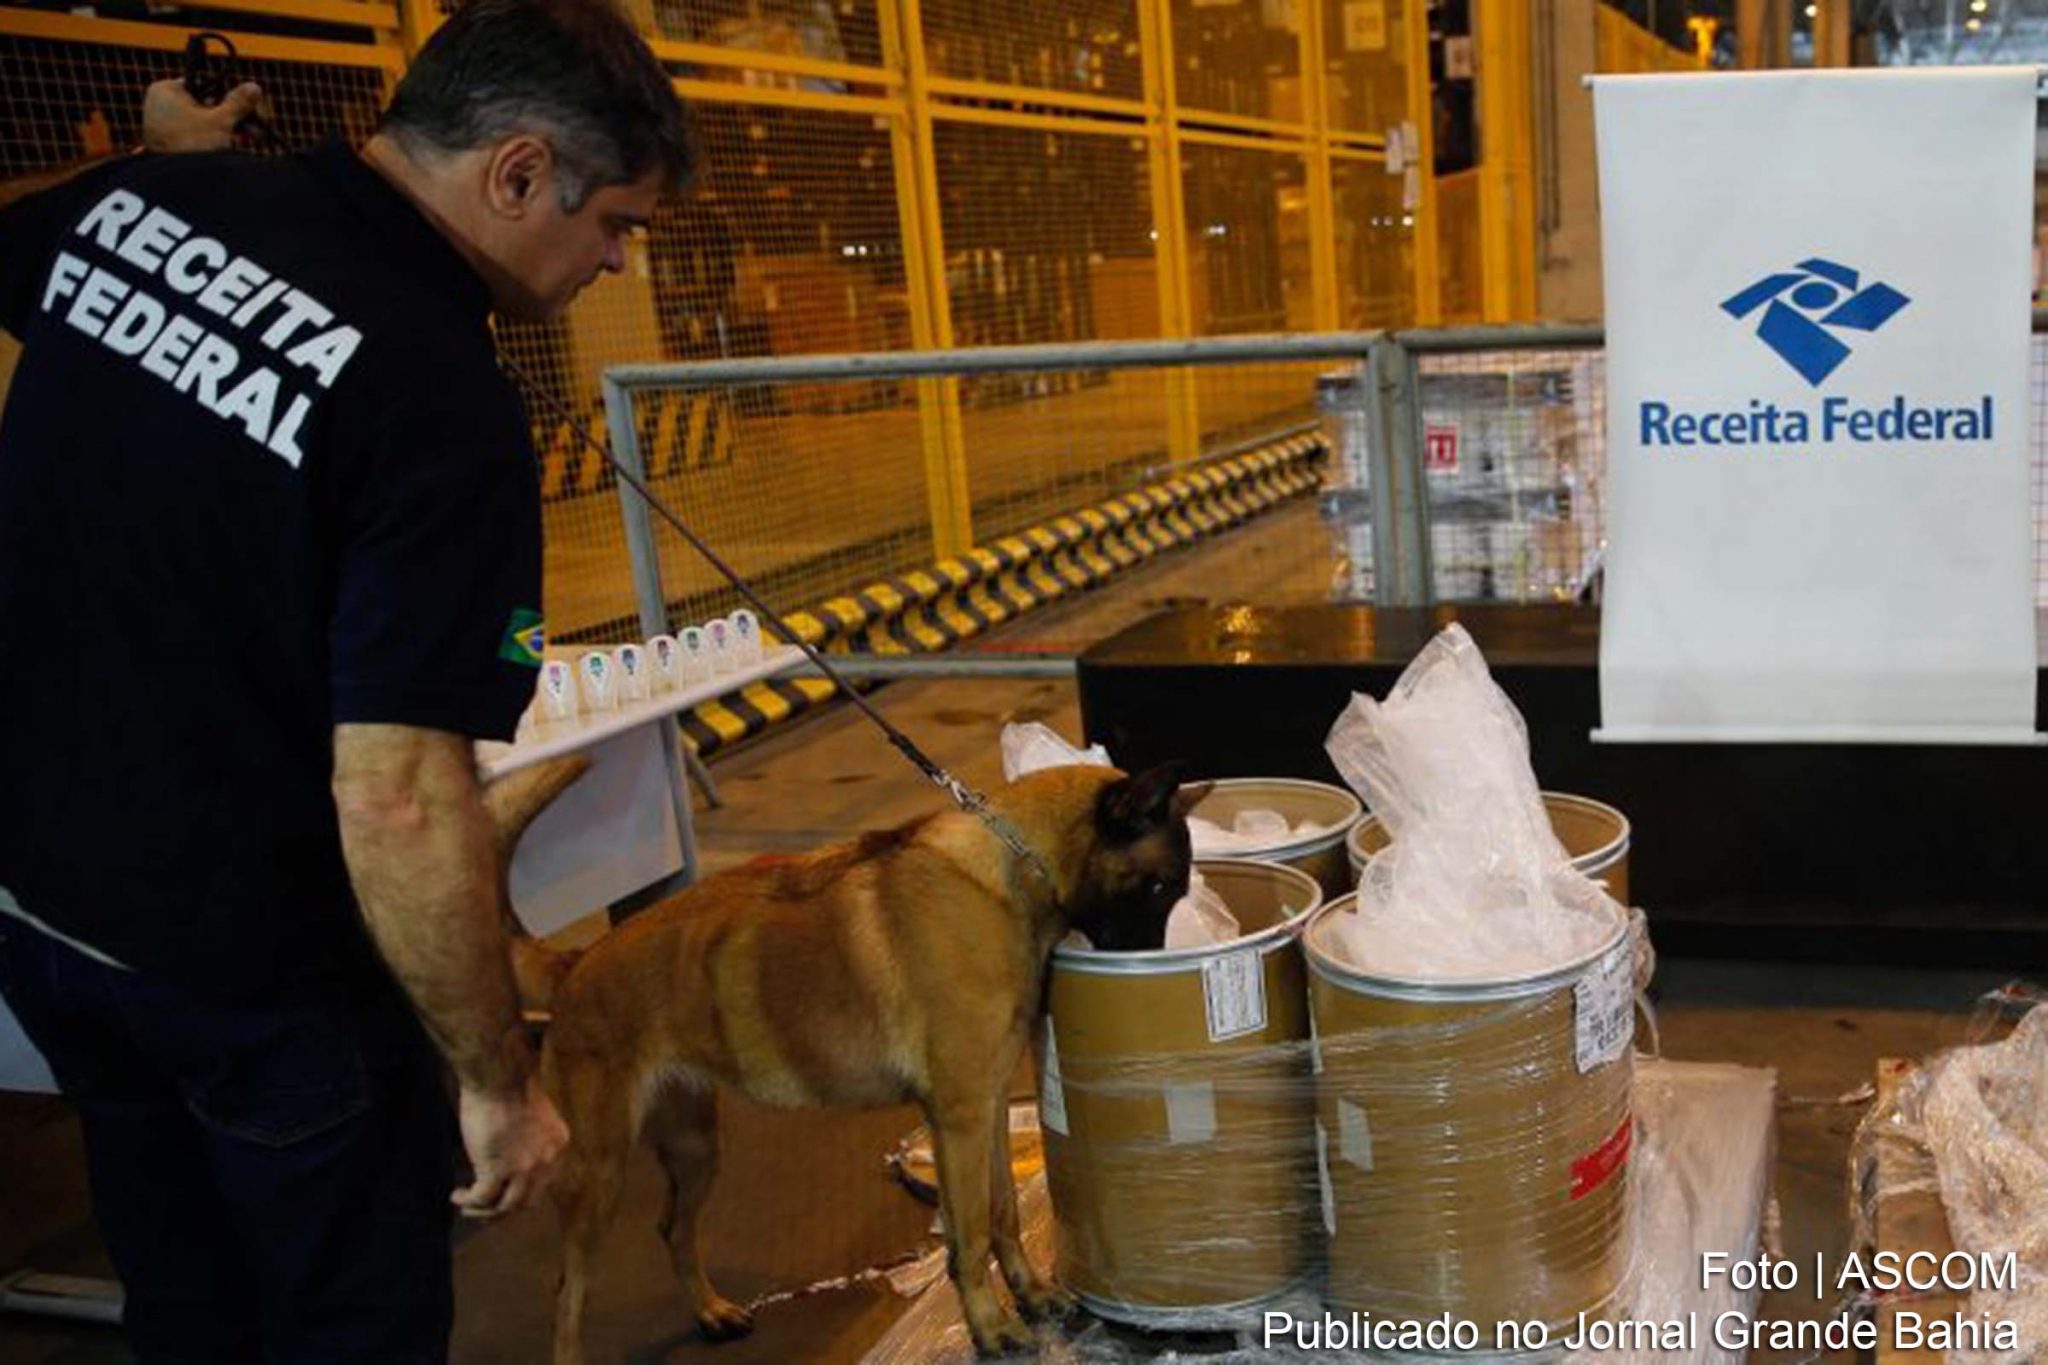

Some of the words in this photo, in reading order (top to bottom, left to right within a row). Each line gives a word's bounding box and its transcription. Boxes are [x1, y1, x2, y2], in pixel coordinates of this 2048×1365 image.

[41, 251, 312, 469] FEDERAL
[75, 188, 363, 388] RECEITA
[1640, 399, 1809, 446] Receita
[1822, 395, 1994, 442] Federal
